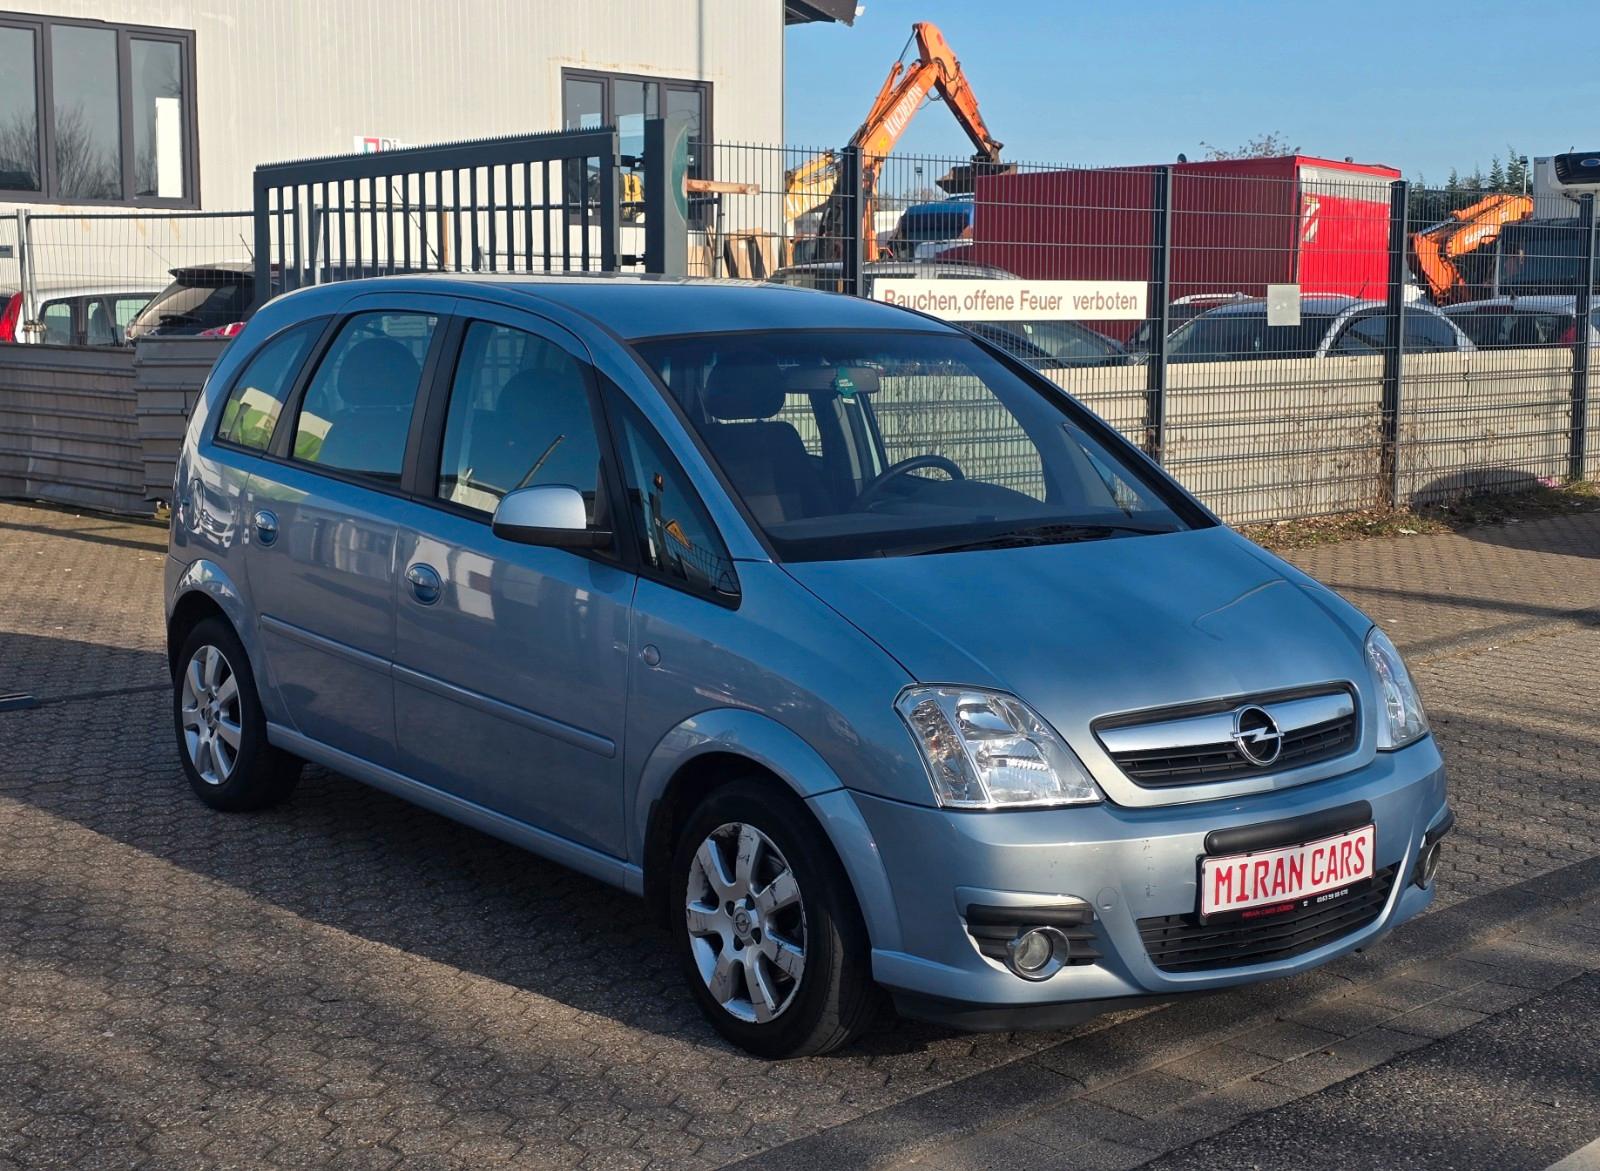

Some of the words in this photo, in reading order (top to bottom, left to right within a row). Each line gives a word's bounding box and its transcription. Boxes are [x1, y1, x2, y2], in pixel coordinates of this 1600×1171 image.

[964, 289, 1014, 311] offene
[1020, 290, 1063, 310] Feuer
[1073, 291, 1137, 311] verboten
[1214, 853, 1304, 905] MIRAN
[1311, 836, 1366, 886] CARS
